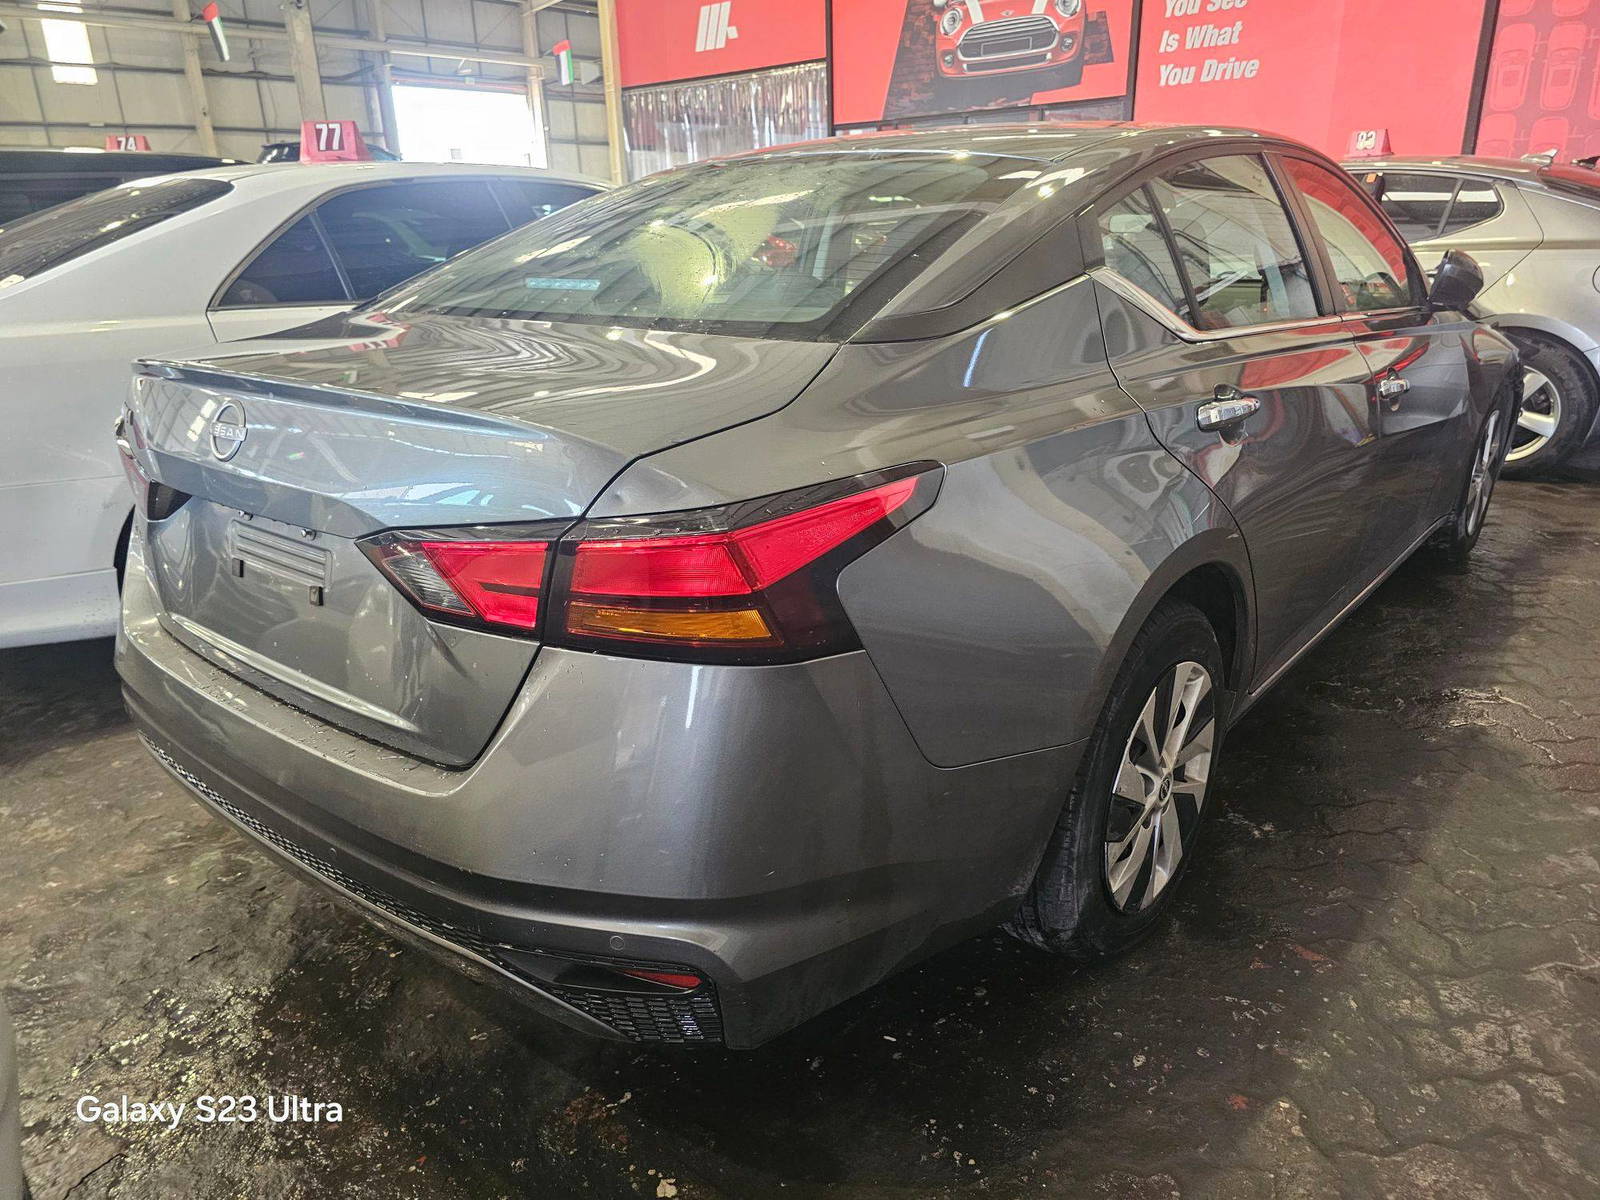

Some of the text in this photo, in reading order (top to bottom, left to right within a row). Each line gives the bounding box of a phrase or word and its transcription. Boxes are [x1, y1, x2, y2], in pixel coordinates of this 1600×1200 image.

[1165, 0, 1201, 18] You
[1159, 20, 1243, 53] Is What
[1159, 56, 1260, 87] You Drive
[117, 136, 137, 152] 74
[315, 122, 341, 151] 77
